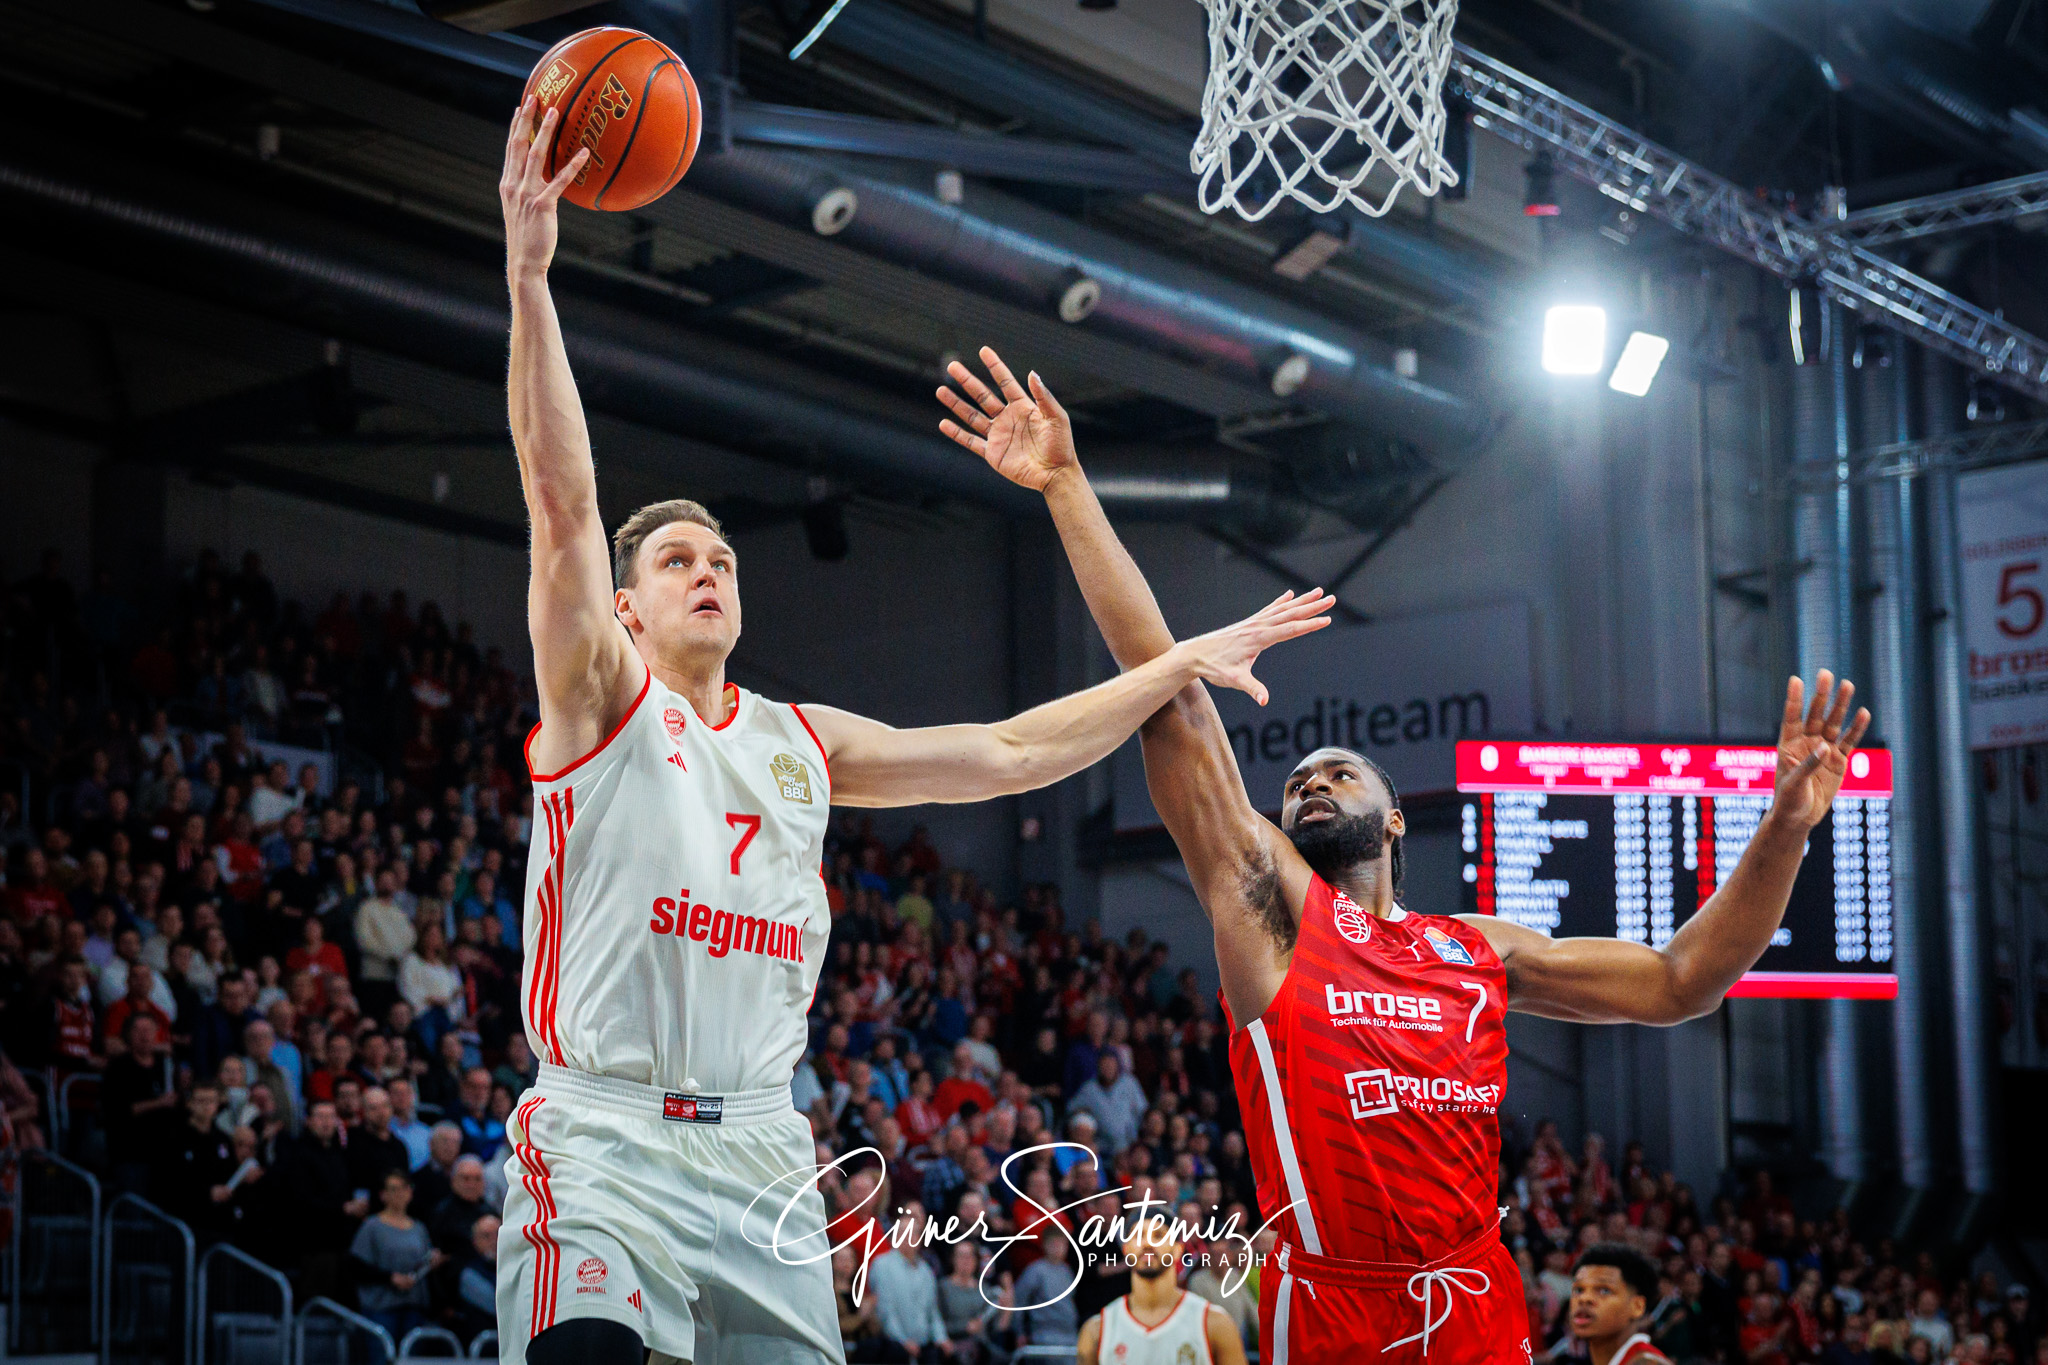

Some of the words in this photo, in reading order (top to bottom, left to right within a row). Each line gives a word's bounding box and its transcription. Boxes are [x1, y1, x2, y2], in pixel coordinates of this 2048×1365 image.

[1997, 561, 2045, 640] 5
[783, 785, 809, 801] BBL
[725, 811, 761, 876] 7
[1325, 983, 1442, 1021] brose
[1460, 981, 1488, 1043] 7
[1331, 1017, 1372, 1028] Technik
[1373, 1018, 1387, 1028] für
[1388, 1023, 1444, 1033] Automobile
[1437, 1103, 1479, 1113] starts
